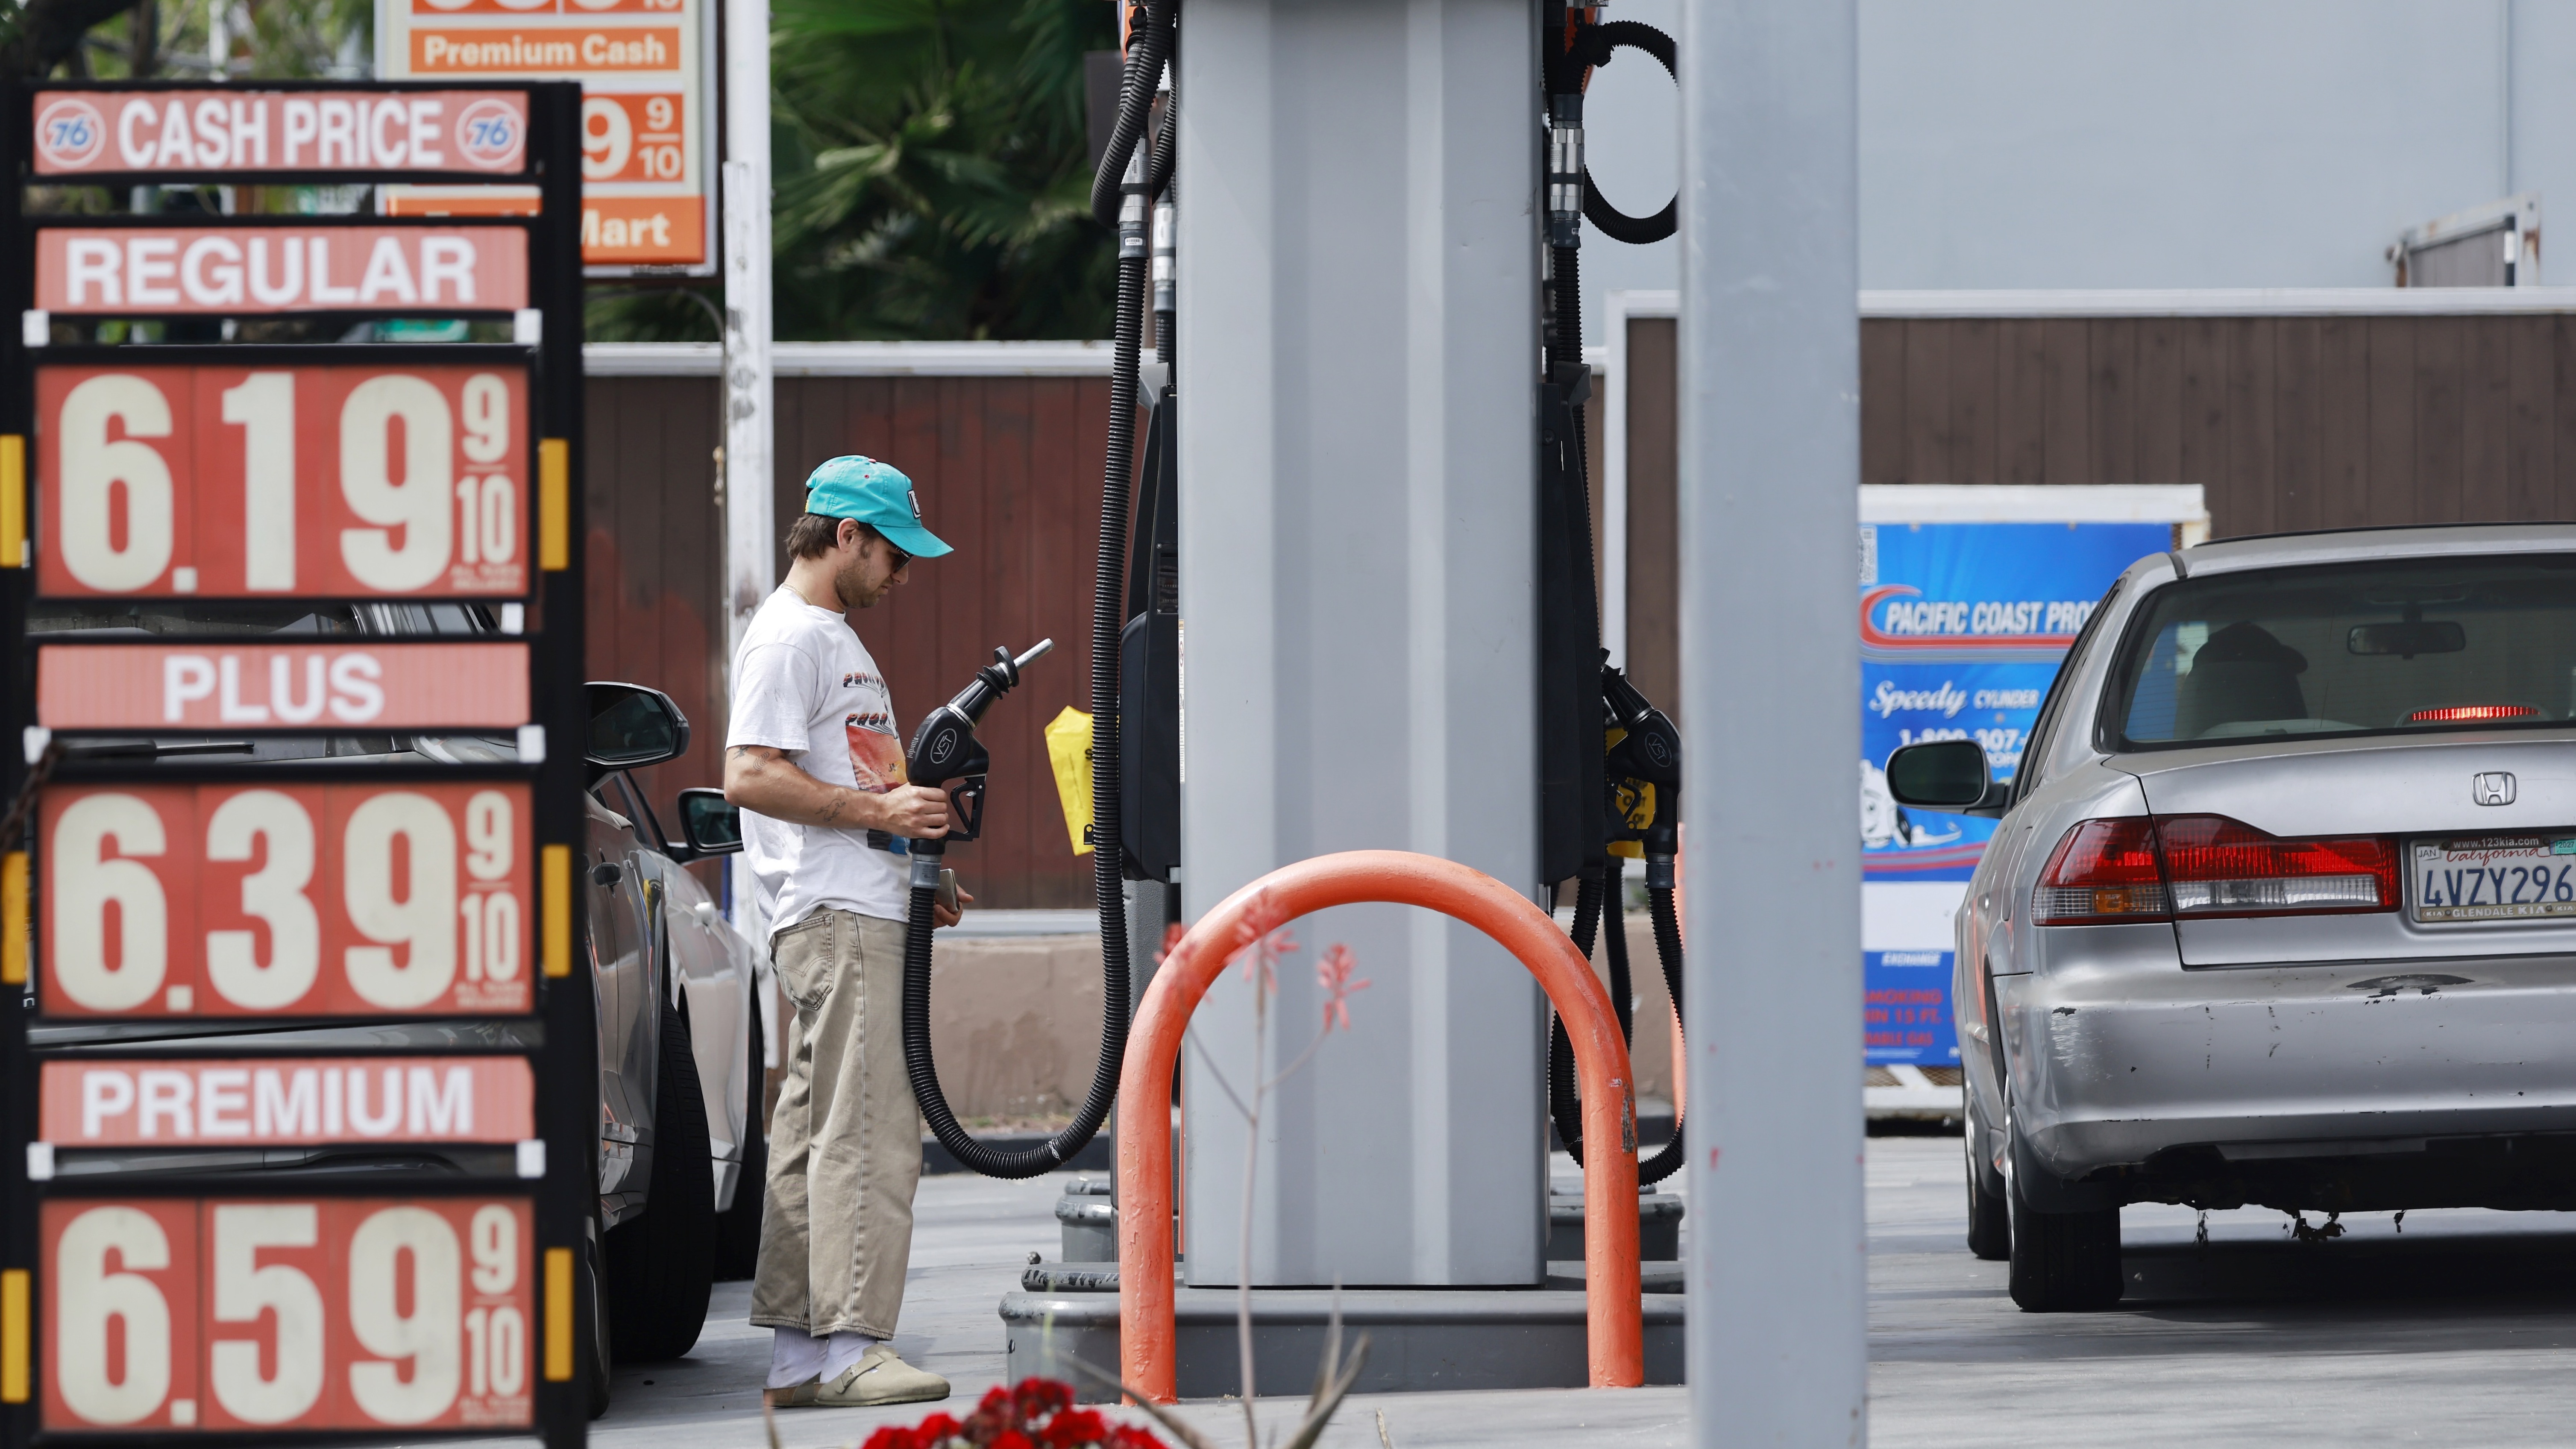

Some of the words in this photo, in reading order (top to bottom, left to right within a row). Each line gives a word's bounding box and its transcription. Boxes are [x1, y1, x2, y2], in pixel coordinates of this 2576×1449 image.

[424, 35, 575, 65] Premium
[582, 33, 666, 65] Cash
[48, 115, 91, 150] 76
[118, 99, 268, 167] CASH
[283, 98, 443, 167] PRICE
[469, 115, 511, 148] 76
[582, 97, 633, 179] 9
[67, 236, 476, 306] REGULAR
[59, 373, 453, 593] 6.19
[1884, 601, 1969, 635] PACIFIC
[1971, 600, 2044, 635] COAST
[164, 653, 385, 723] PLUS
[1869, 680, 1968, 719] Speedy
[1973, 689, 2039, 709] CYLINDER
[933, 734, 952, 758] VST
[1649, 737, 1667, 760] VST
[1899, 727, 2030, 752] 1-800-307-
[1623, 795, 1646, 807] OT
[2418, 849, 2437, 858] JAN
[2447, 848, 2550, 867] California
[2453, 837, 2539, 848] www.123kia.com
[53, 790, 458, 1011] 6.39
[2424, 864, 2573, 906] 4VZY296
[2452, 907, 2514, 918] GLENDALE
[2518, 905, 2545, 915] KIA
[82, 1066, 473, 1138] PREMIUM
[57, 1204, 462, 1426] 6.59
